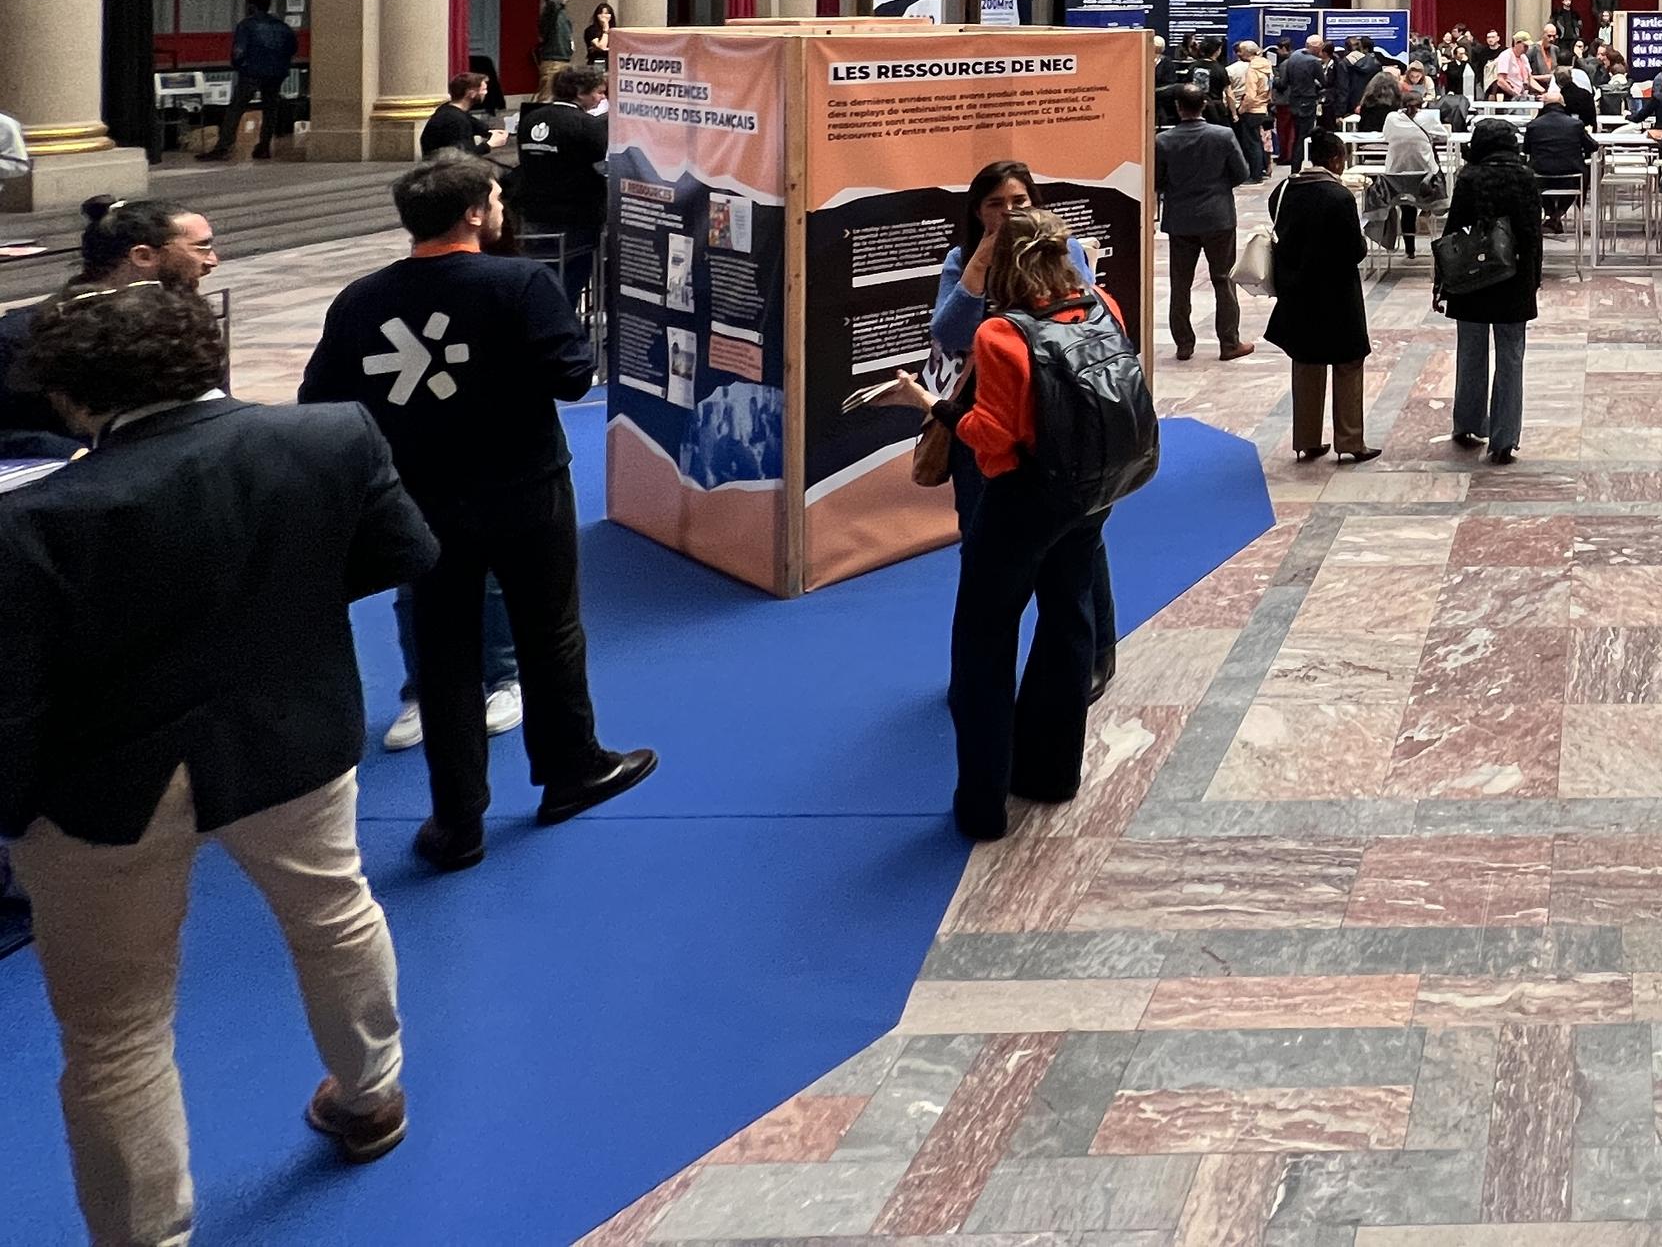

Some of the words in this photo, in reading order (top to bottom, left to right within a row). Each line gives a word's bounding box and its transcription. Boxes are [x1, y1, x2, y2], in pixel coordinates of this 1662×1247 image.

[1633, 31, 1640, 41] à
[1641, 31, 1651, 41] la
[1633, 44, 1647, 54] du
[619, 54, 682, 74] DÉVELOPPER
[832, 65, 871, 81] LES
[877, 61, 1006, 79] RESSOURCES
[1011, 59, 1035, 73] DE
[1040, 58, 1074, 72] NEC
[1633, 57, 1646, 67] de
[619, 80, 634, 93] LES
[636, 79, 709, 101] COMPÉTENCES
[828, 99, 848, 107] Ces
[850, 97, 896, 106] dernières
[898, 94, 932, 103] années
[934, 93, 957, 102] nous
[959, 92, 985, 100] avons
[987, 89, 1017, 99] produit
[1036, 87, 1062, 95] vidéos
[1063, 85, 1110, 94] explicatives,
[827, 120, 883, 130] ressources
[885, 118, 906, 127] sont
[908, 113, 960, 124] accessibles
[962, 113, 974, 121] en
[975, 111, 1006, 120] licence
[1007, 108, 1039, 117] ouverte
[1054, 106, 1065, 114] BY
[1067, 105, 1078, 113] SA
[1079, 104, 1093, 112] 4.0.
[828, 110, 847, 119] des
[849, 109, 885, 118] replays
[901, 104, 953, 114] webinaires
[954, 103, 964, 111] et
[966, 102, 977, 110] de
[979, 100, 1025, 109] rencontres
[1039, 96, 1080, 106] présentiel.
[682, 108, 702, 124] DES
[705, 111, 755, 133] FRANÇAIS
[828, 130, 883, 141] Découvrez
[893, 127, 927, 136] d'entre
[929, 125, 950, 133] elles
[952, 123, 973, 132] pour
[975, 121, 994, 130] aller
[996, 120, 1014, 129] plus
[1015, 119, 1031, 127] loin
[1056, 113, 1100, 123] thématique
